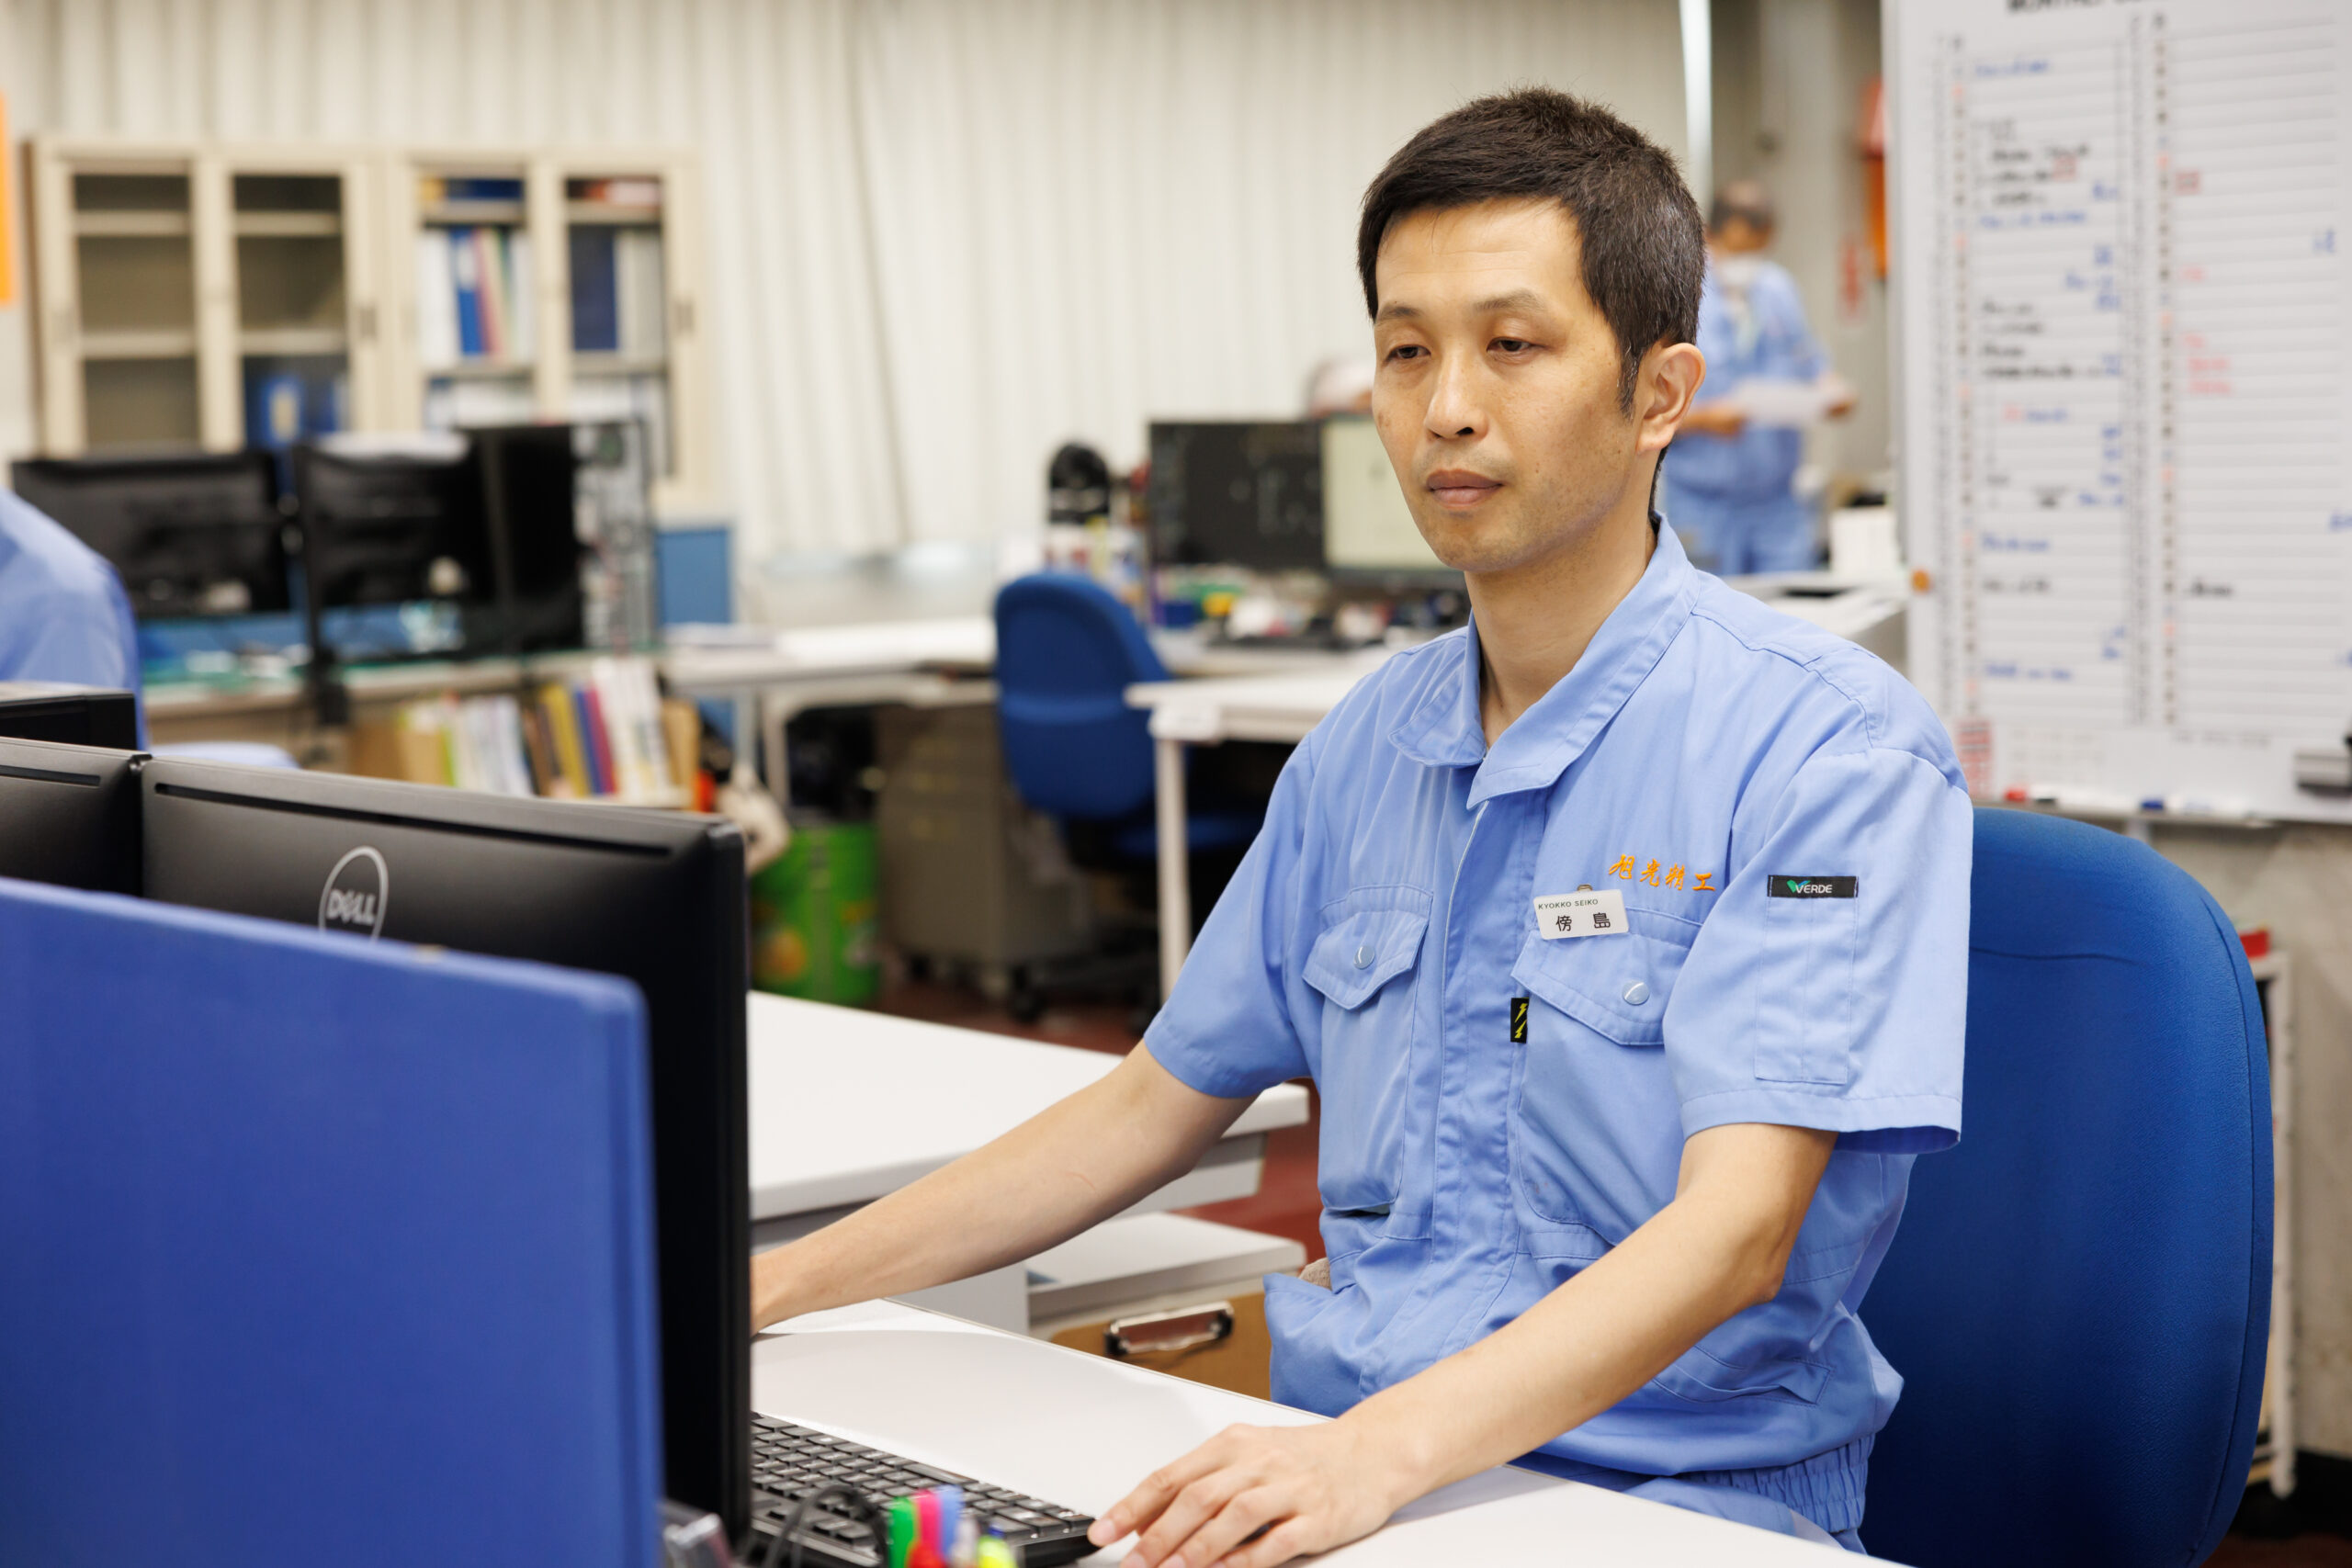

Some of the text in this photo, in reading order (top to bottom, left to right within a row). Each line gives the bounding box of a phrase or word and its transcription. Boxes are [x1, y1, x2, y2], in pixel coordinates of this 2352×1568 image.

[1609, 853, 1715, 891] 旭光精工
[1794, 884, 1833, 894] VERDE
[326, 888, 376, 925] DELL
[1538, 898, 1599, 909] KYOKKO SEIKO
[1556, 912, 1611, 931] 傍島
